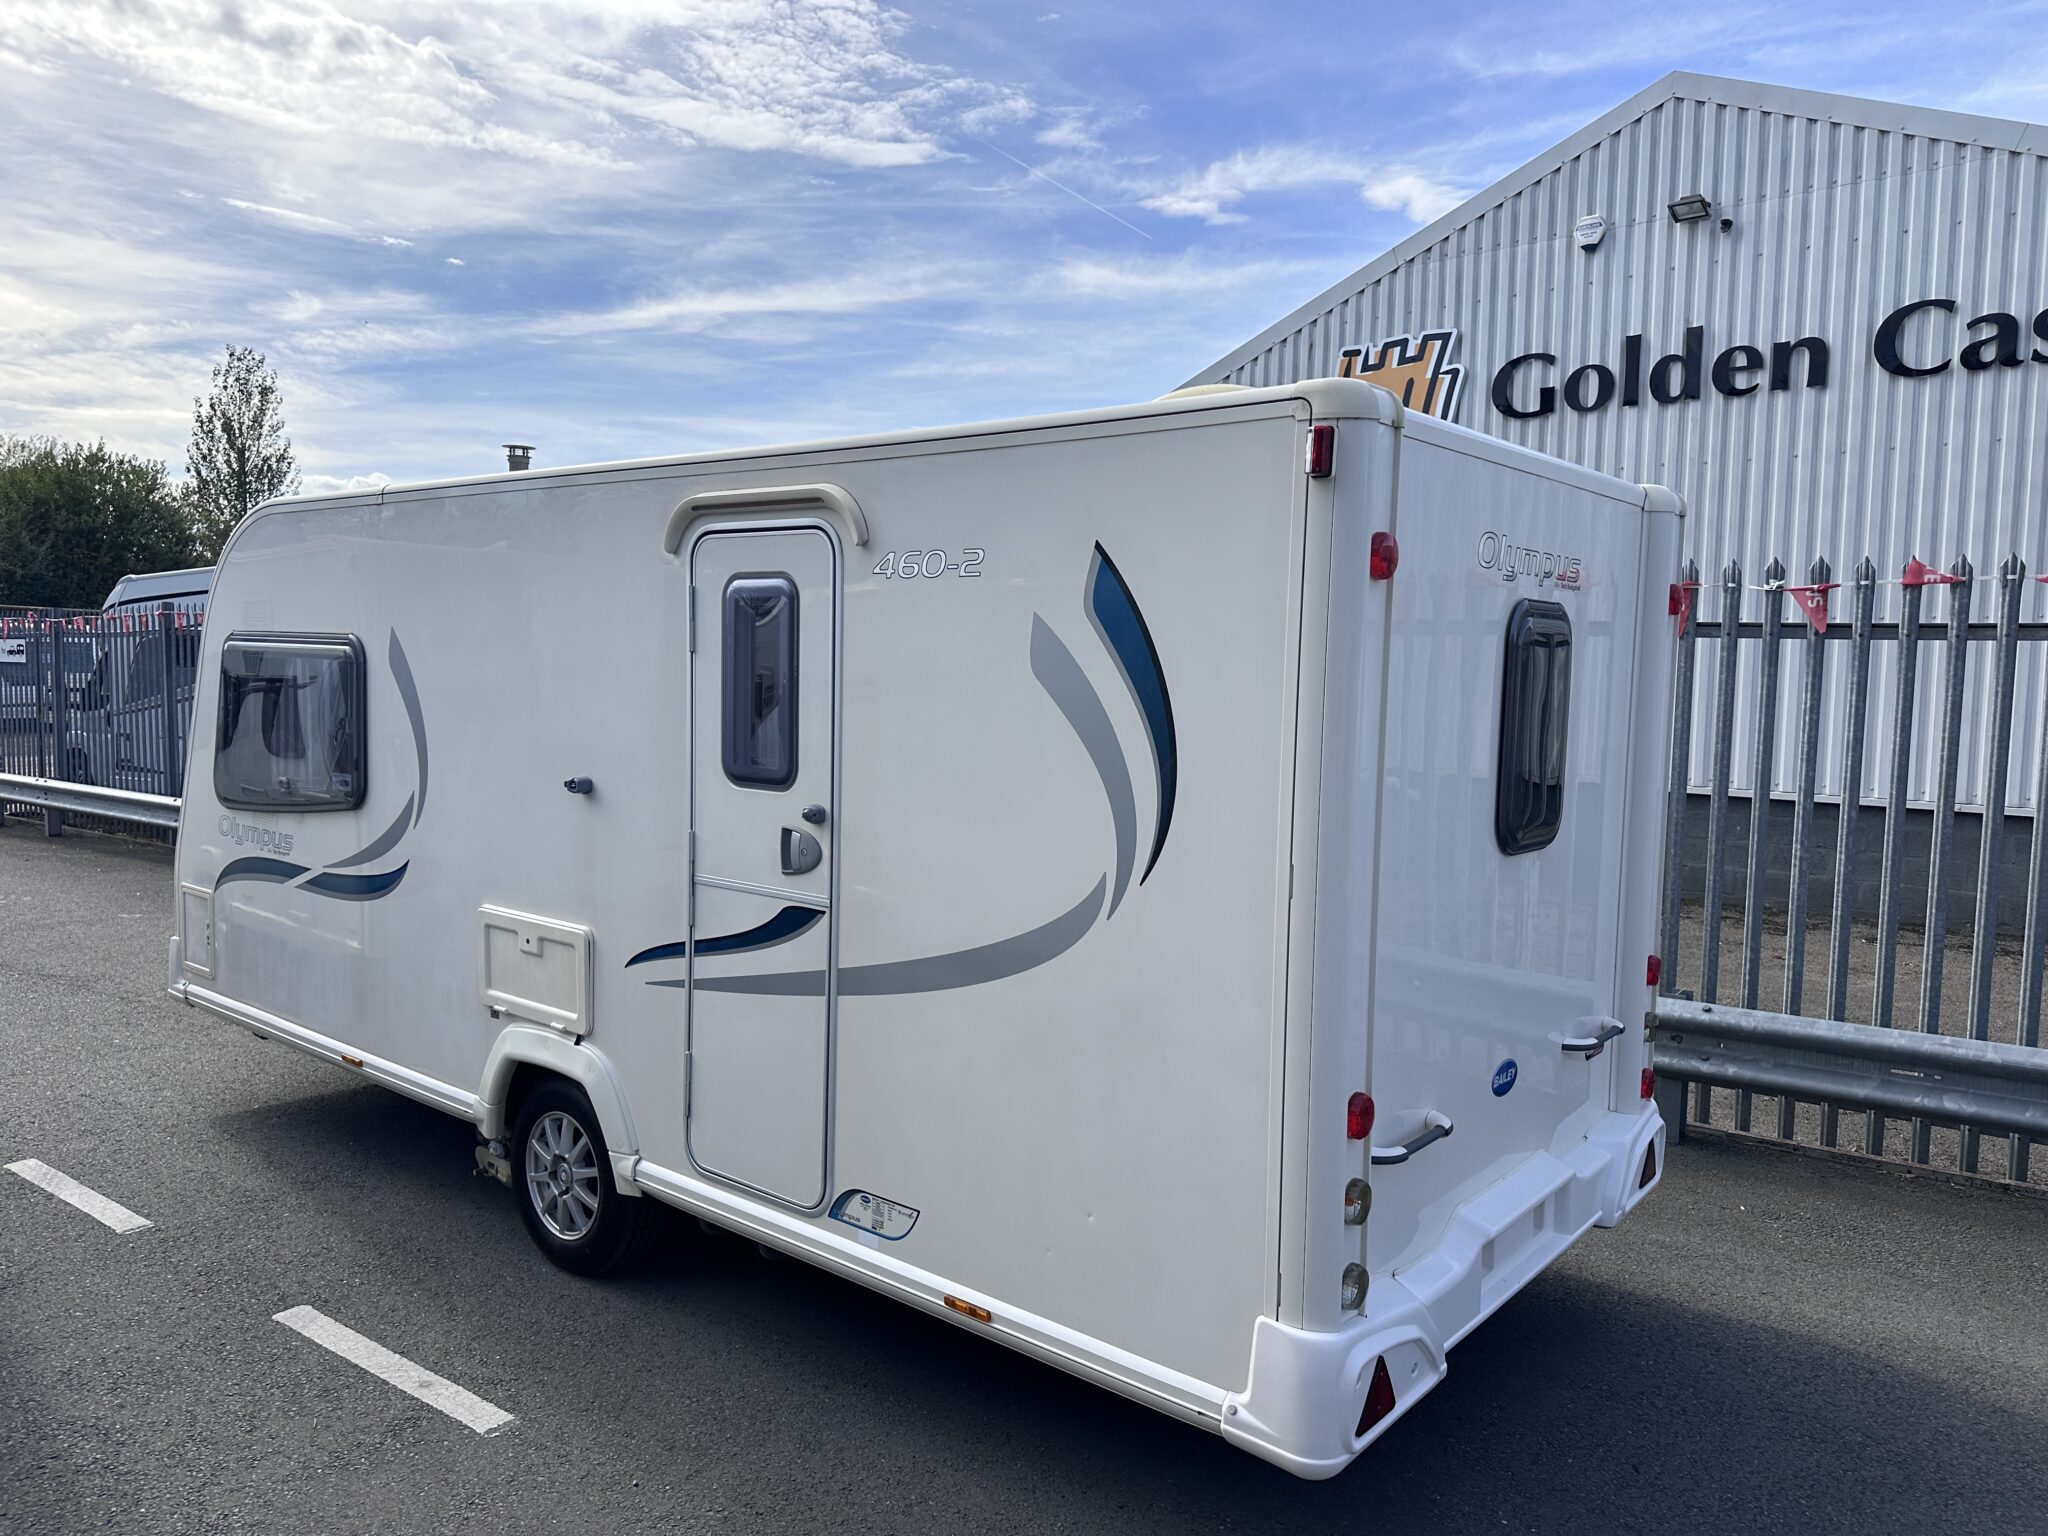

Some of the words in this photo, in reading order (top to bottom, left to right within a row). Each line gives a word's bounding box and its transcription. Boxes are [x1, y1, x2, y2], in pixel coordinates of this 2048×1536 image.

[1491, 324, 1830, 419] Golden
[872, 547, 985, 579] 460-2
[1477, 531, 1581, 587] Olympus
[218, 815, 294, 851] Olympus
[1493, 1066, 1517, 1088] BAILEY
